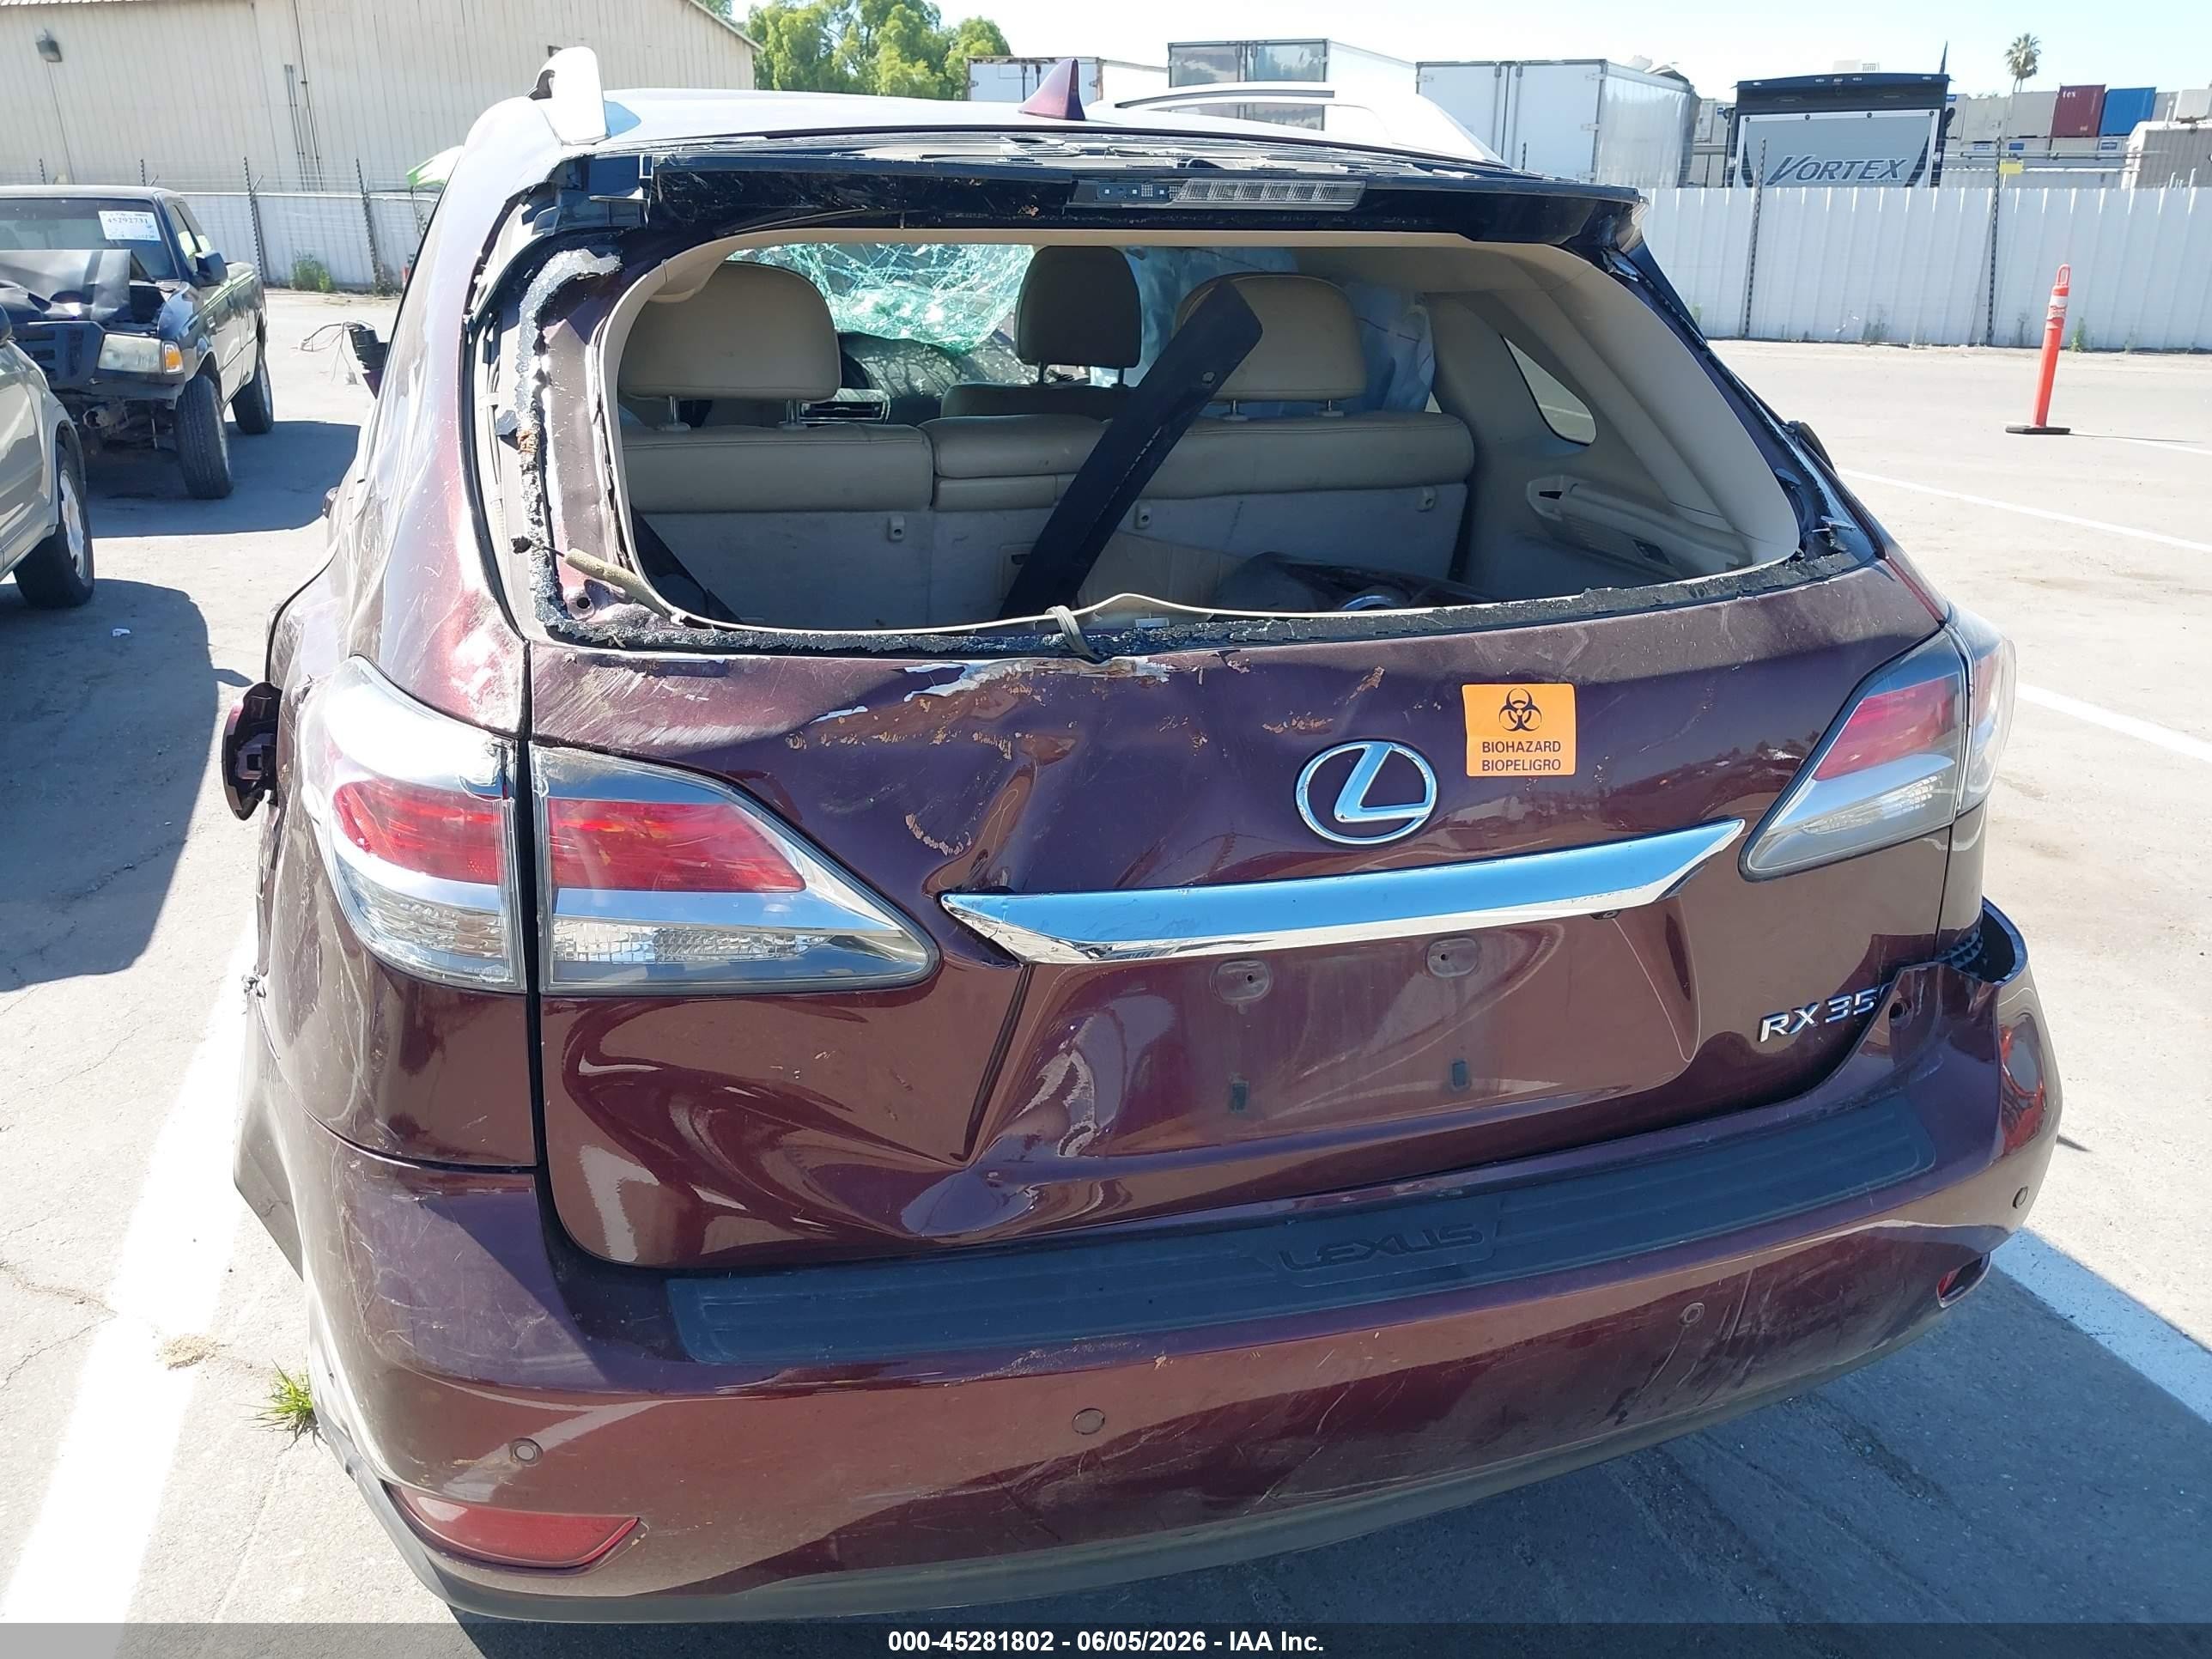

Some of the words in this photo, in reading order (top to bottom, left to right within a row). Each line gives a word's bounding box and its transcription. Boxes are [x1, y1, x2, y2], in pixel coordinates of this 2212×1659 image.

[1765, 155, 1908, 186] VORTEX
[1481, 740, 1562, 753] BIOHAZARD
[1481, 758, 1562, 772] BIOPELIGRO
[1759, 1001, 1820, 1042] RX
[1824, 983, 1889, 1023] 35
[1279, 1223, 1485, 1272] LEXUS
